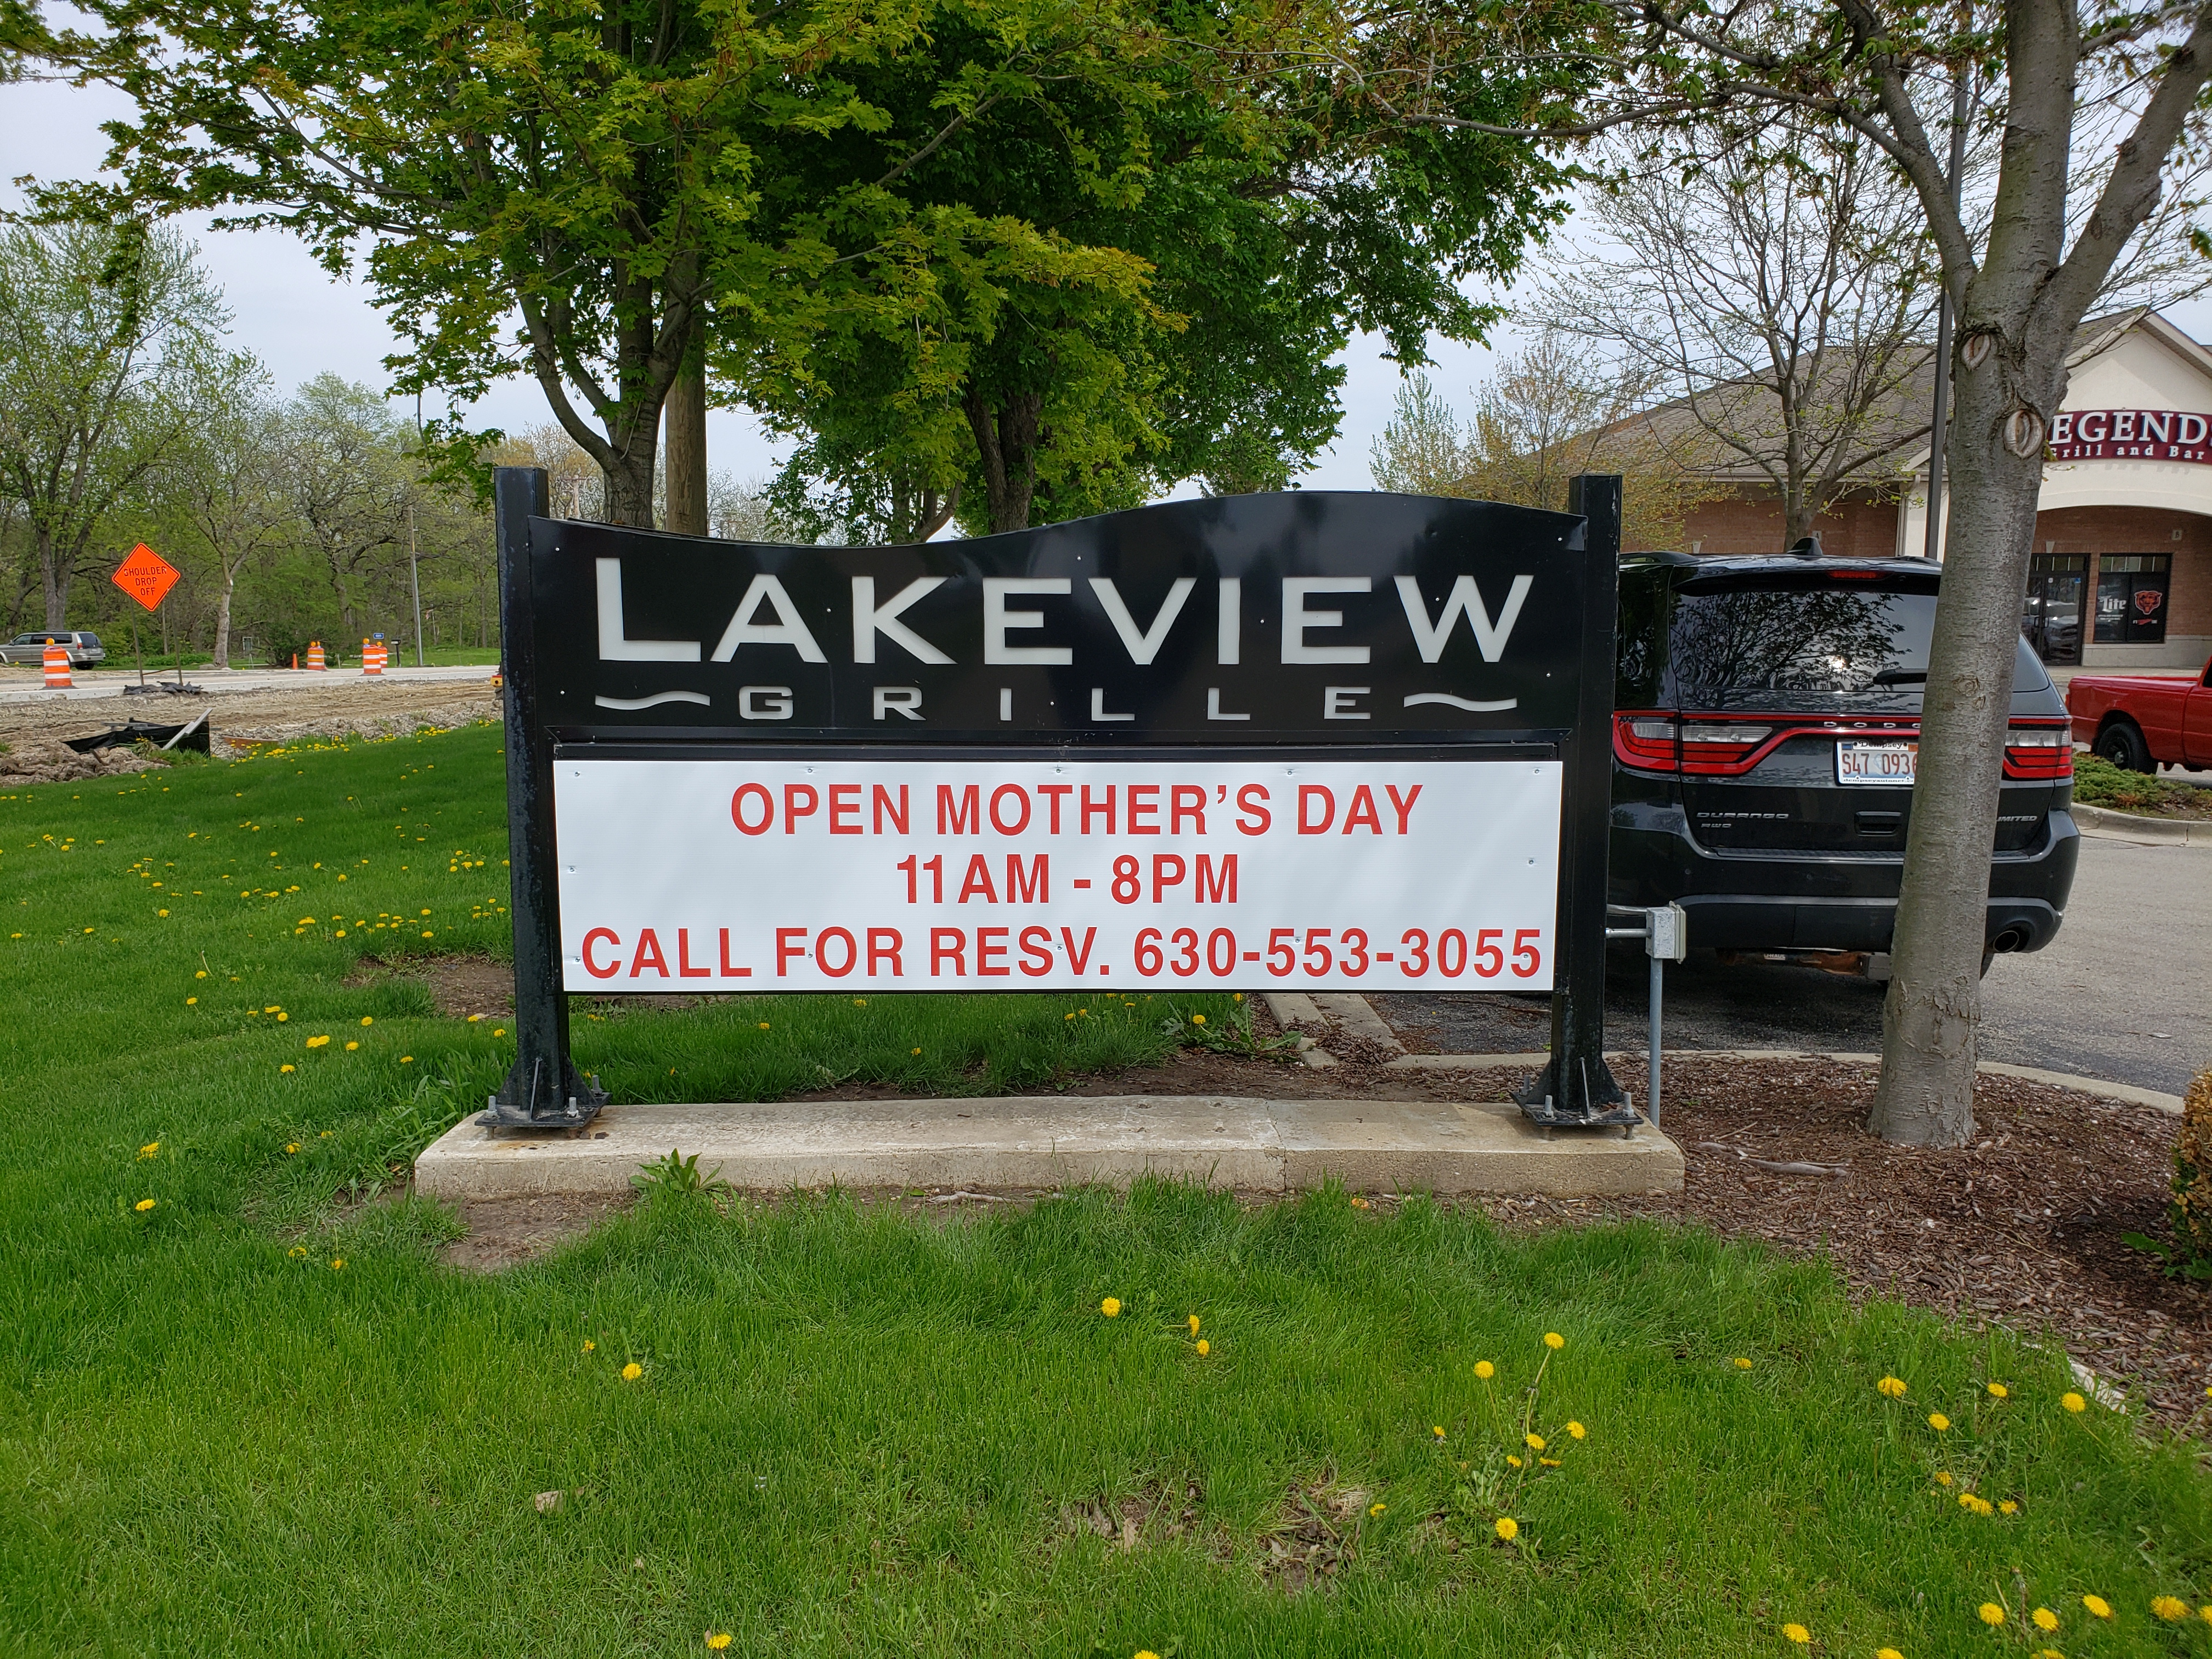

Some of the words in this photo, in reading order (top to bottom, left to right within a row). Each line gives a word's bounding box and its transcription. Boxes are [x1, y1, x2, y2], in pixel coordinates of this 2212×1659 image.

[2049, 411, 2212, 445] EGEND
[2117, 444, 2153, 456] and
[2169, 445, 2204, 460] Bar
[124, 566, 167, 577] SHOULDER
[135, 577, 157, 586] DROP
[140, 587, 155, 596] OFF
[2099, 595, 2126, 612] Lite
[596, 556, 1534, 665] LAKEVIEW
[739, 686, 1371, 721] GRILLE
[1859, 740, 1903, 749] Dempsey
[731, 783, 910, 836] OPEN
[936, 783, 1271, 836] MOTHER'S
[1298, 785, 1423, 834] DAY
[898, 854, 1049, 904] 11AM
[1074, 879, 1091, 889] -
[1111, 854, 1238, 905] 8PM
[582, 927, 752, 979] CALL
[776, 927, 904, 978] FOR
[930, 926, 1110, 977] RESV.
[1134, 928, 1541, 978] 630-553-3055
